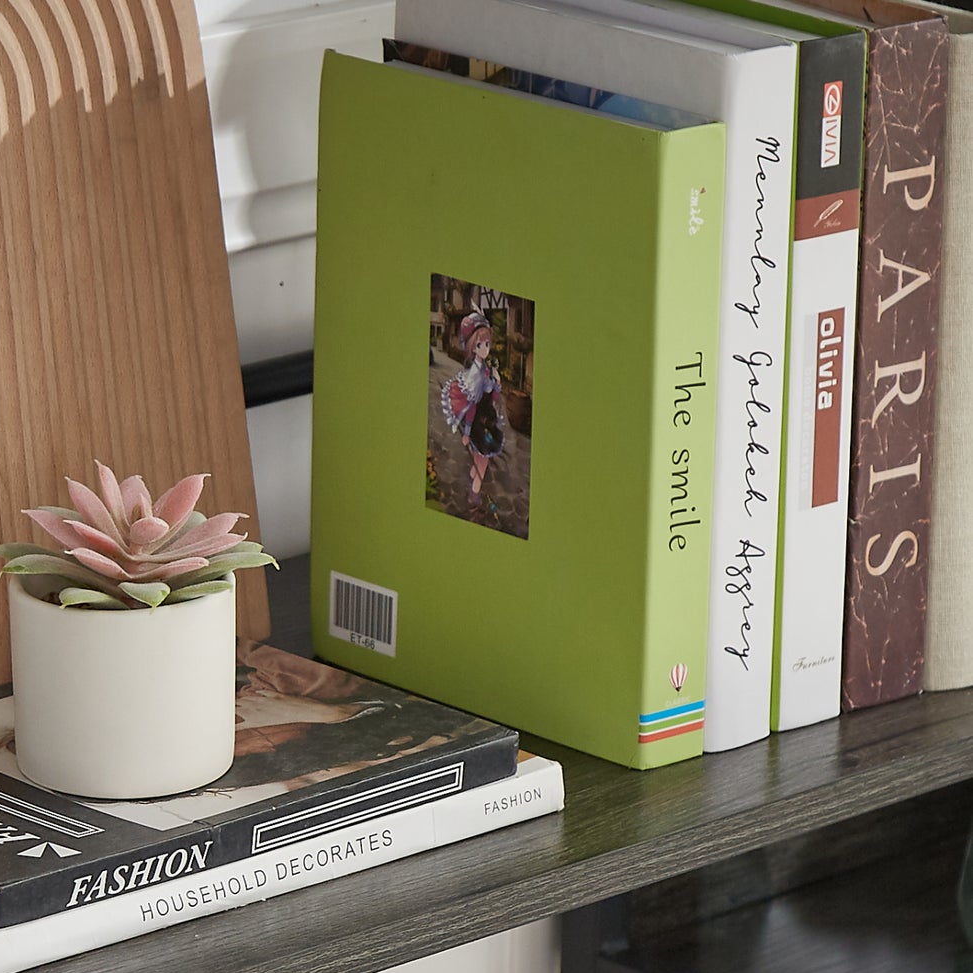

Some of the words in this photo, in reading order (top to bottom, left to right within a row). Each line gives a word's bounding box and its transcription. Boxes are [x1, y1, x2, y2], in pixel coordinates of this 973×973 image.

[673, 352, 707, 428] The
[817, 317, 842, 410] olivia
[864, 155, 936, 577] PARIS
[668, 448, 701, 551] smile
[483, 787, 542, 816] FASHION
[66, 841, 213, 908] FASHION
[139, 869, 268, 922] HOUSEHOLD
[275, 829, 394, 881] DECORATES
